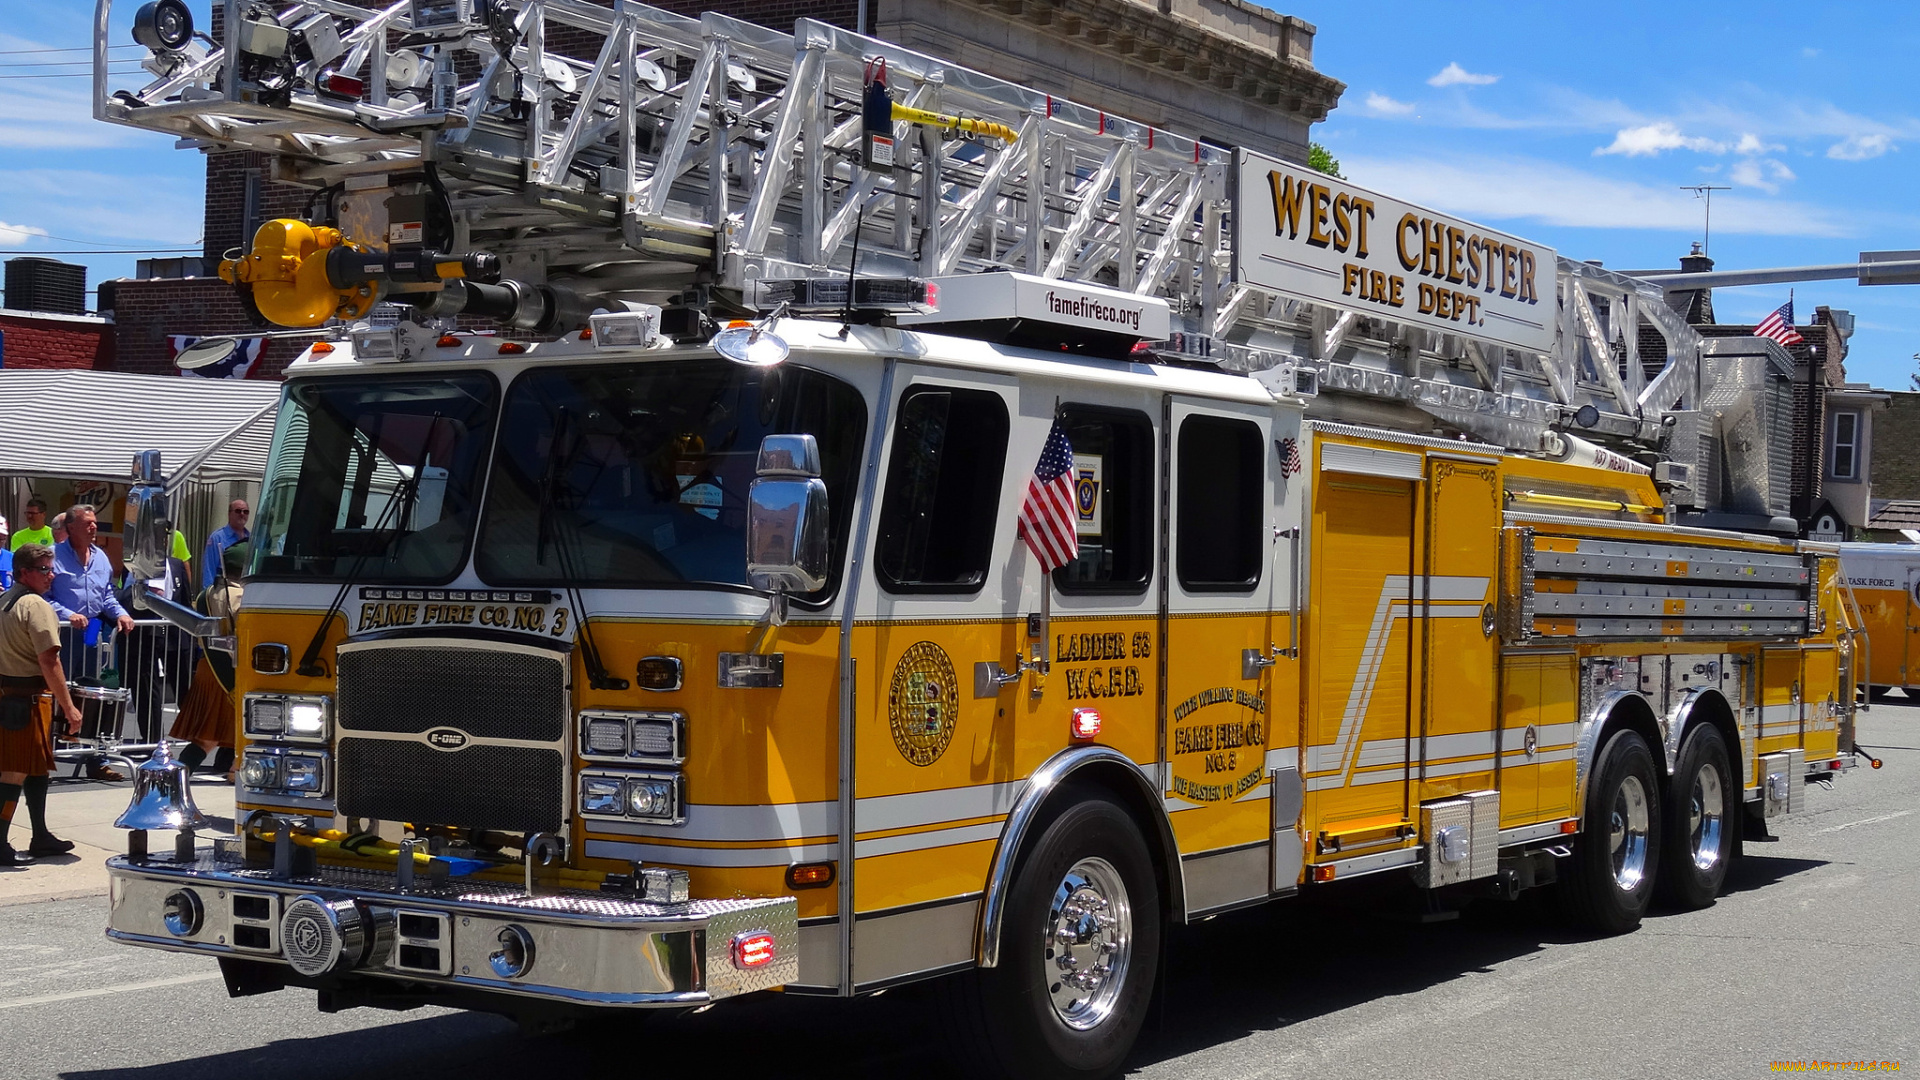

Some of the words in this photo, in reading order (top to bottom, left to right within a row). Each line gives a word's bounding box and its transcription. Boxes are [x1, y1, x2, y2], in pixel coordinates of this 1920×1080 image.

[1266, 170, 1375, 259] WEST
[1396, 211, 1538, 305] CHESTER
[1049, 291, 1139, 330] famefireco.org
[1342, 262, 1405, 308] FIRE
[1418, 282, 1485, 328] DEPT.
[1868, 578, 1895, 587] FORCE
[357, 602, 420, 632] FAME
[422, 604, 476, 626] FIRE
[479, 605, 510, 628] CO.
[511, 606, 546, 632] NO.
[551, 607, 569, 636] 3
[1056, 632, 1126, 663] LADDER
[1132, 631, 1151, 658] 53
[1065, 666, 1144, 700] W.C.F.D.
[1174, 695, 1198, 723] WITH
[1199, 687, 1234, 709] WILLING
[431, 733, 463, 744] E-ONE
[1175, 724, 1213, 755] FAME
[1216, 721, 1244, 750] FIRE
[1246, 720, 1265, 746] CO.
[1205, 752, 1227, 774] NO.
[1174, 775, 1188, 796] WE
[1188, 781, 1221, 802] HASTEN
[1223, 782, 1233, 800] TO
[1236, 765, 1264, 796] ASSIST
